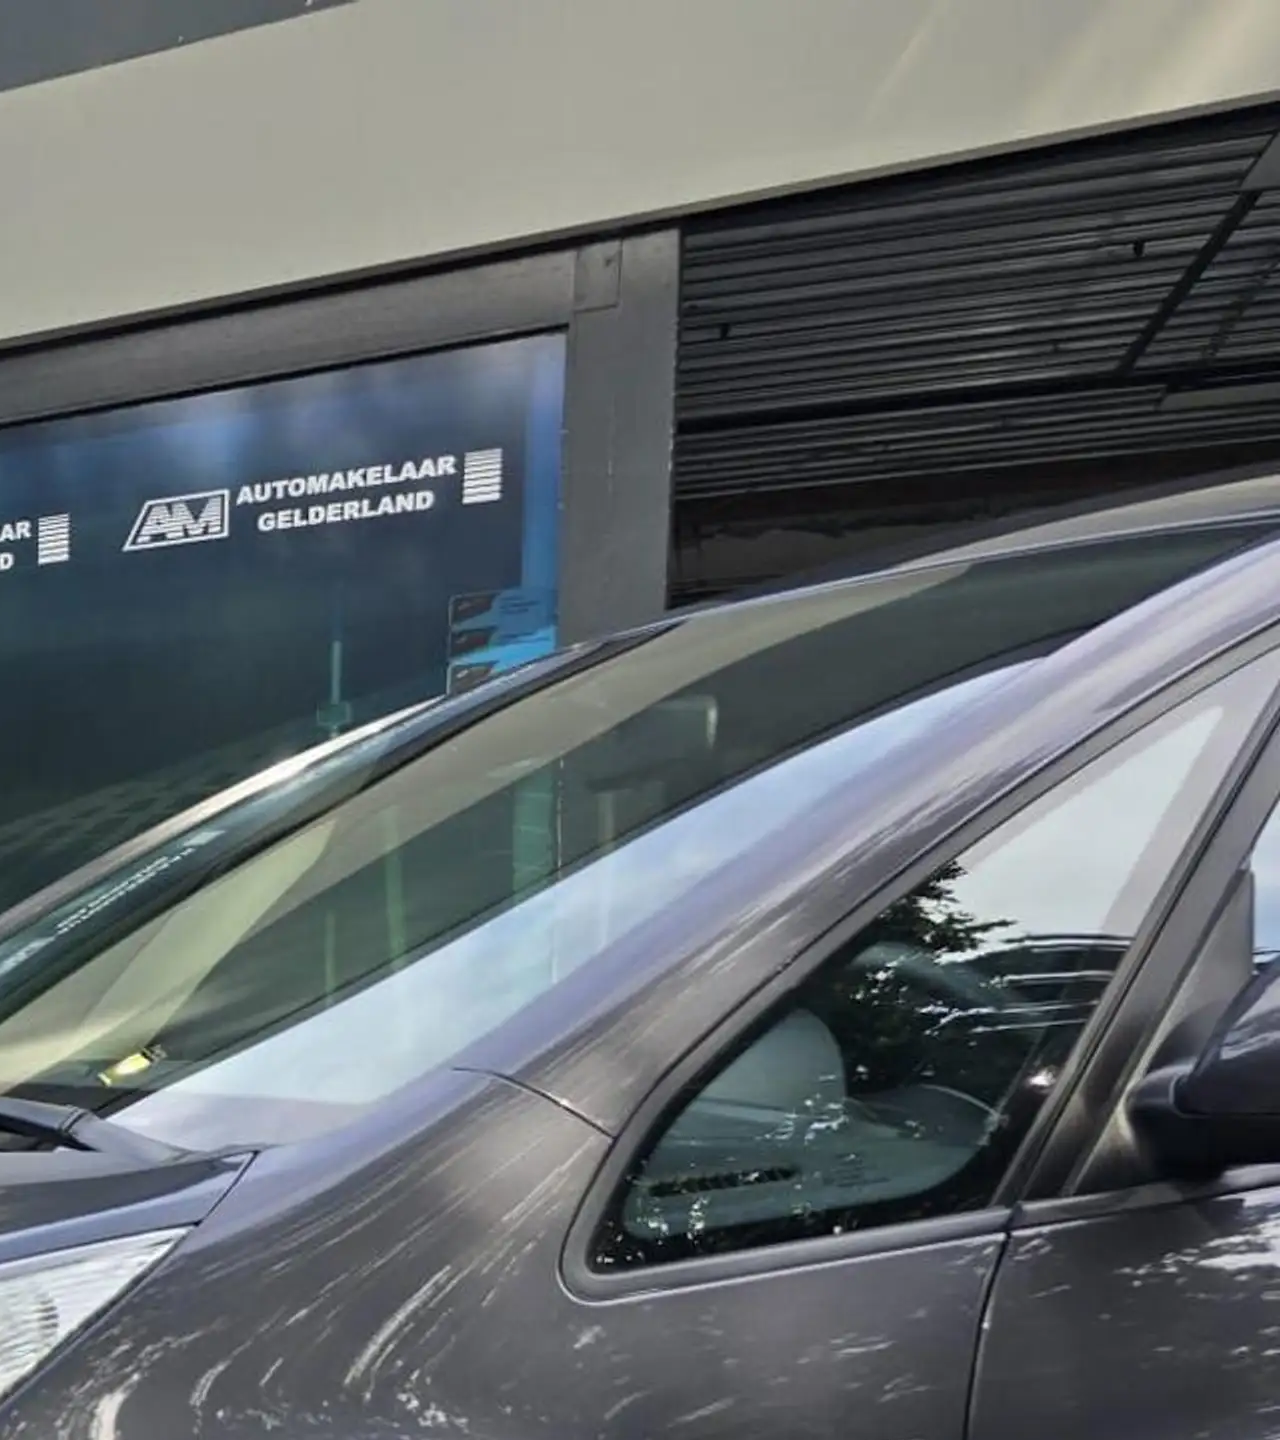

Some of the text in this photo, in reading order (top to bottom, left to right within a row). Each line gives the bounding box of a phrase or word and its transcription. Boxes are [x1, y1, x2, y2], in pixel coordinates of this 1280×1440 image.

[236, 455, 458, 506] AUTOMAKELAAR
[136, 496, 222, 545] AM
[256, 490, 435, 532] GELDERLAND
